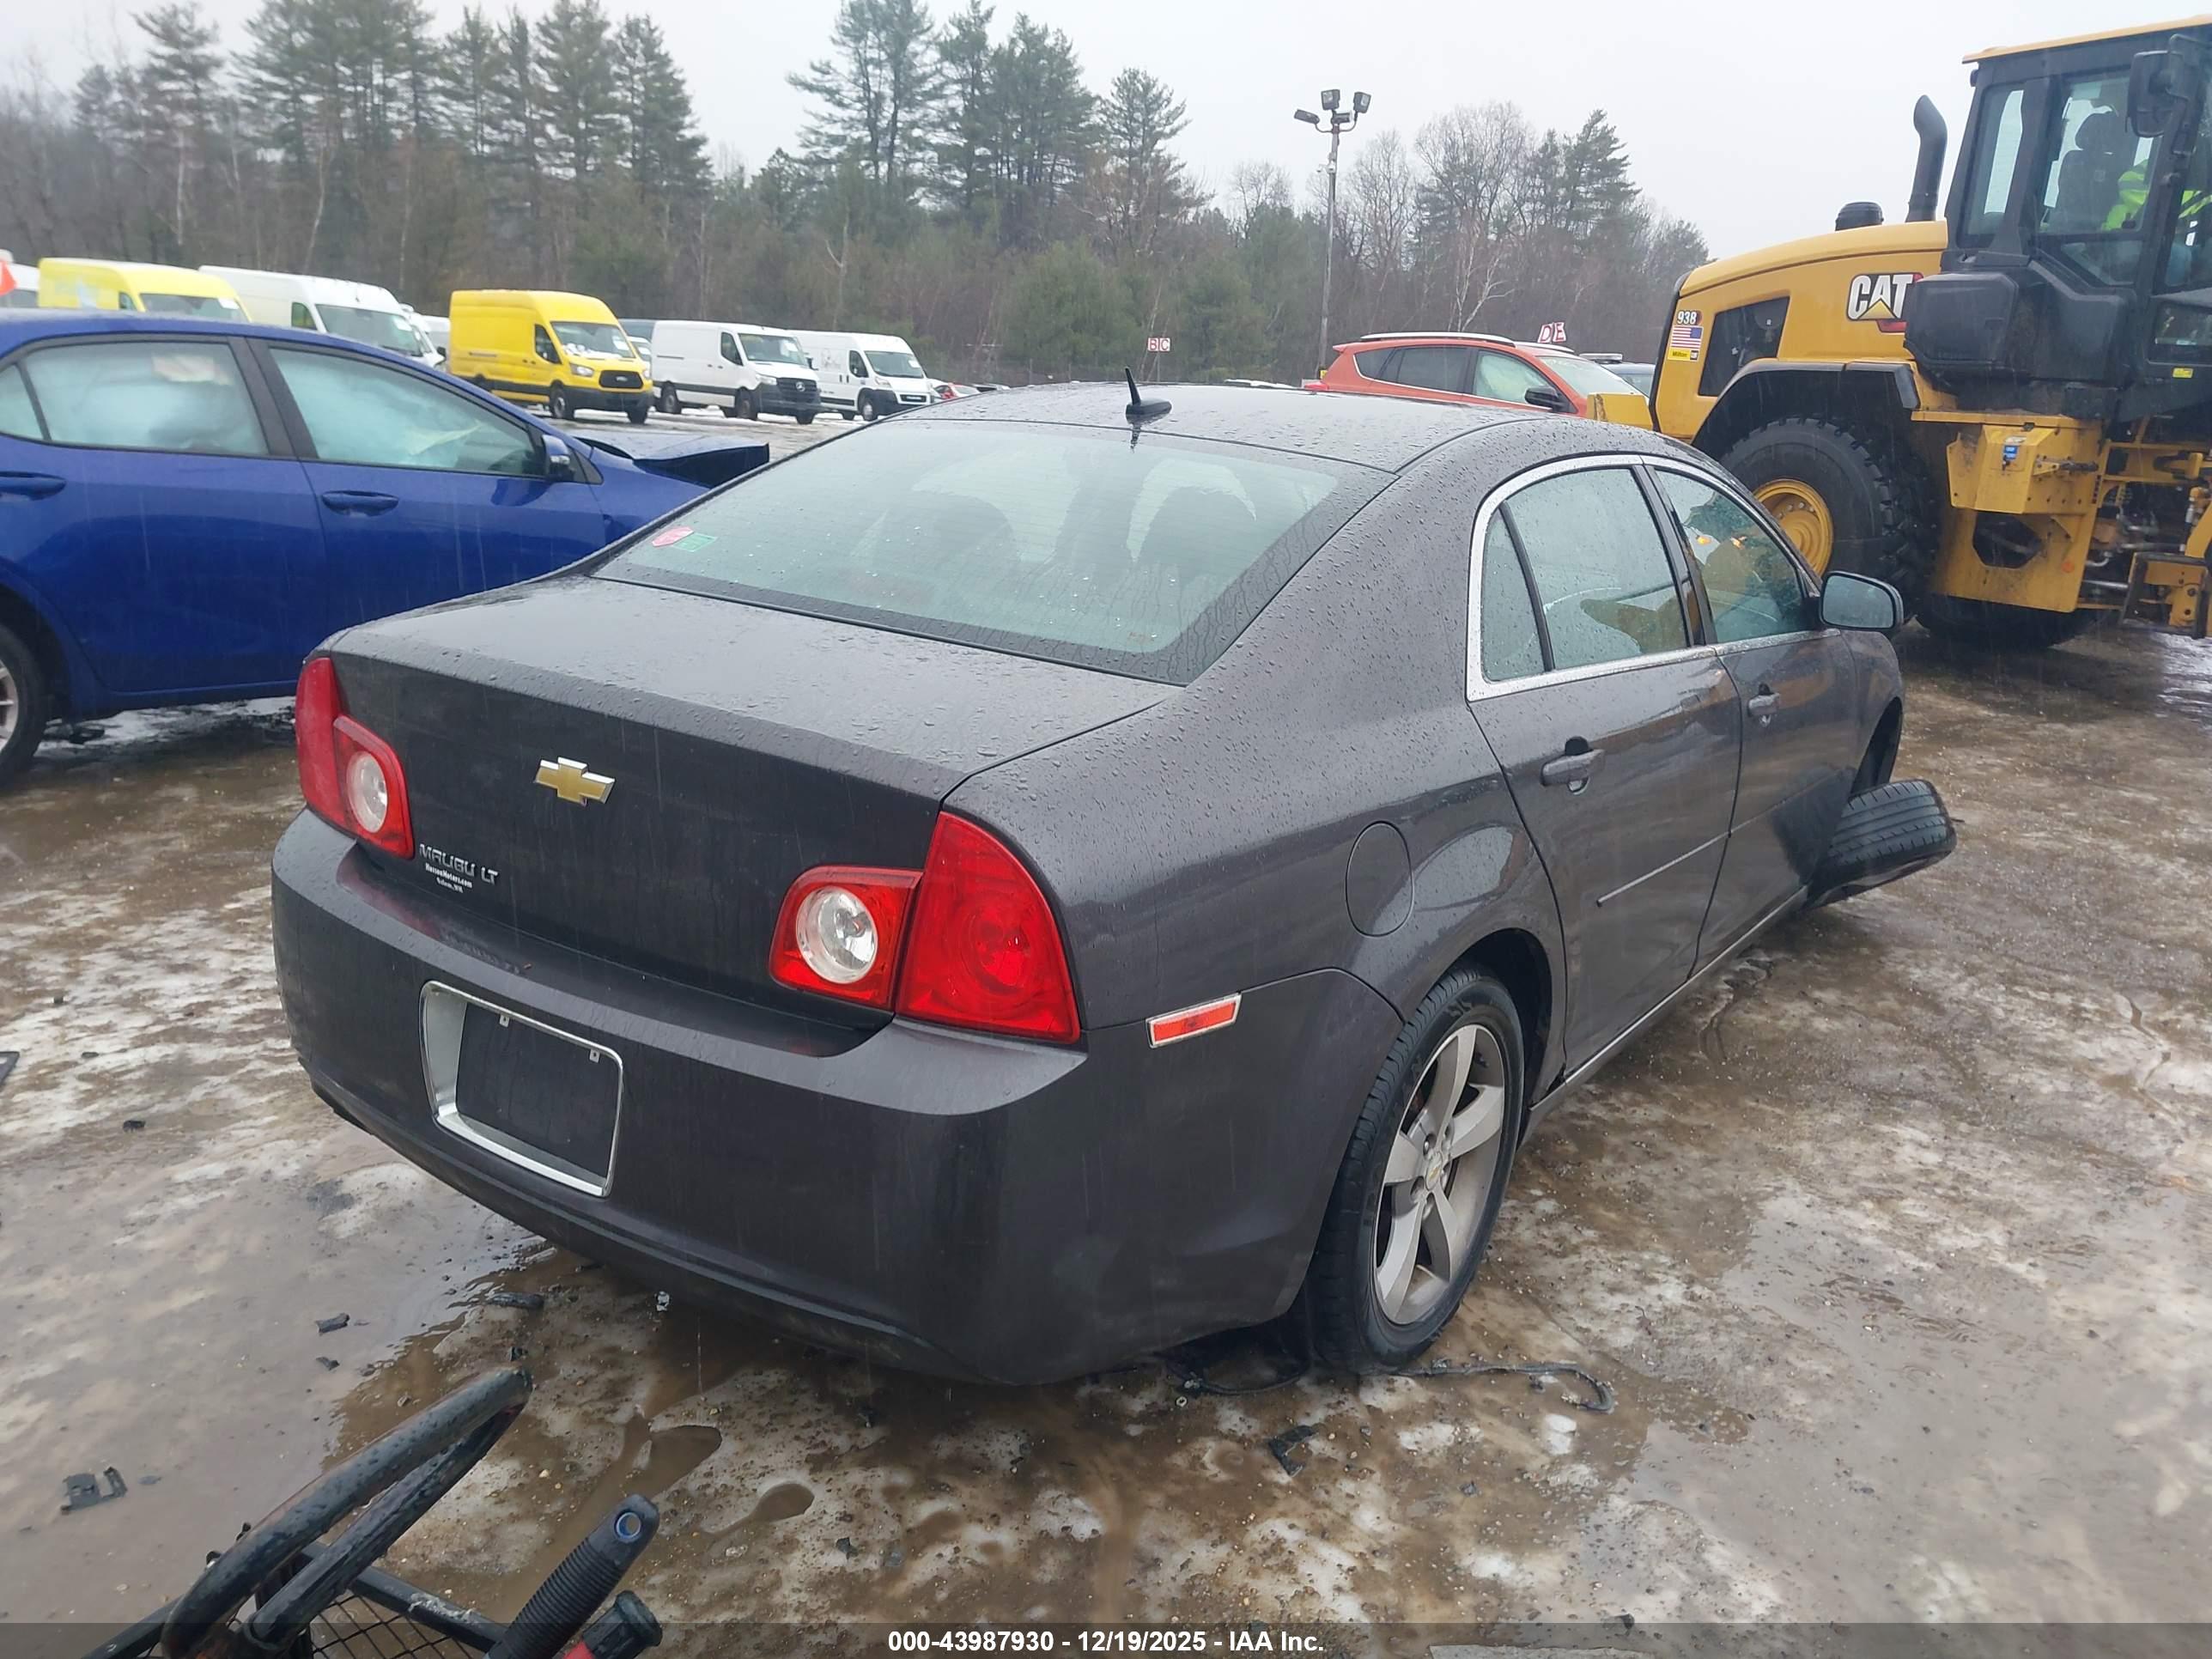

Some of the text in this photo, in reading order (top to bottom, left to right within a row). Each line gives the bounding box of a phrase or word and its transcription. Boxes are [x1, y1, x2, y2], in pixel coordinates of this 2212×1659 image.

[1847, 274, 1914, 319] CAT
[1677, 311, 1698, 325] 938
[419, 843, 499, 885] MALIBU LT
